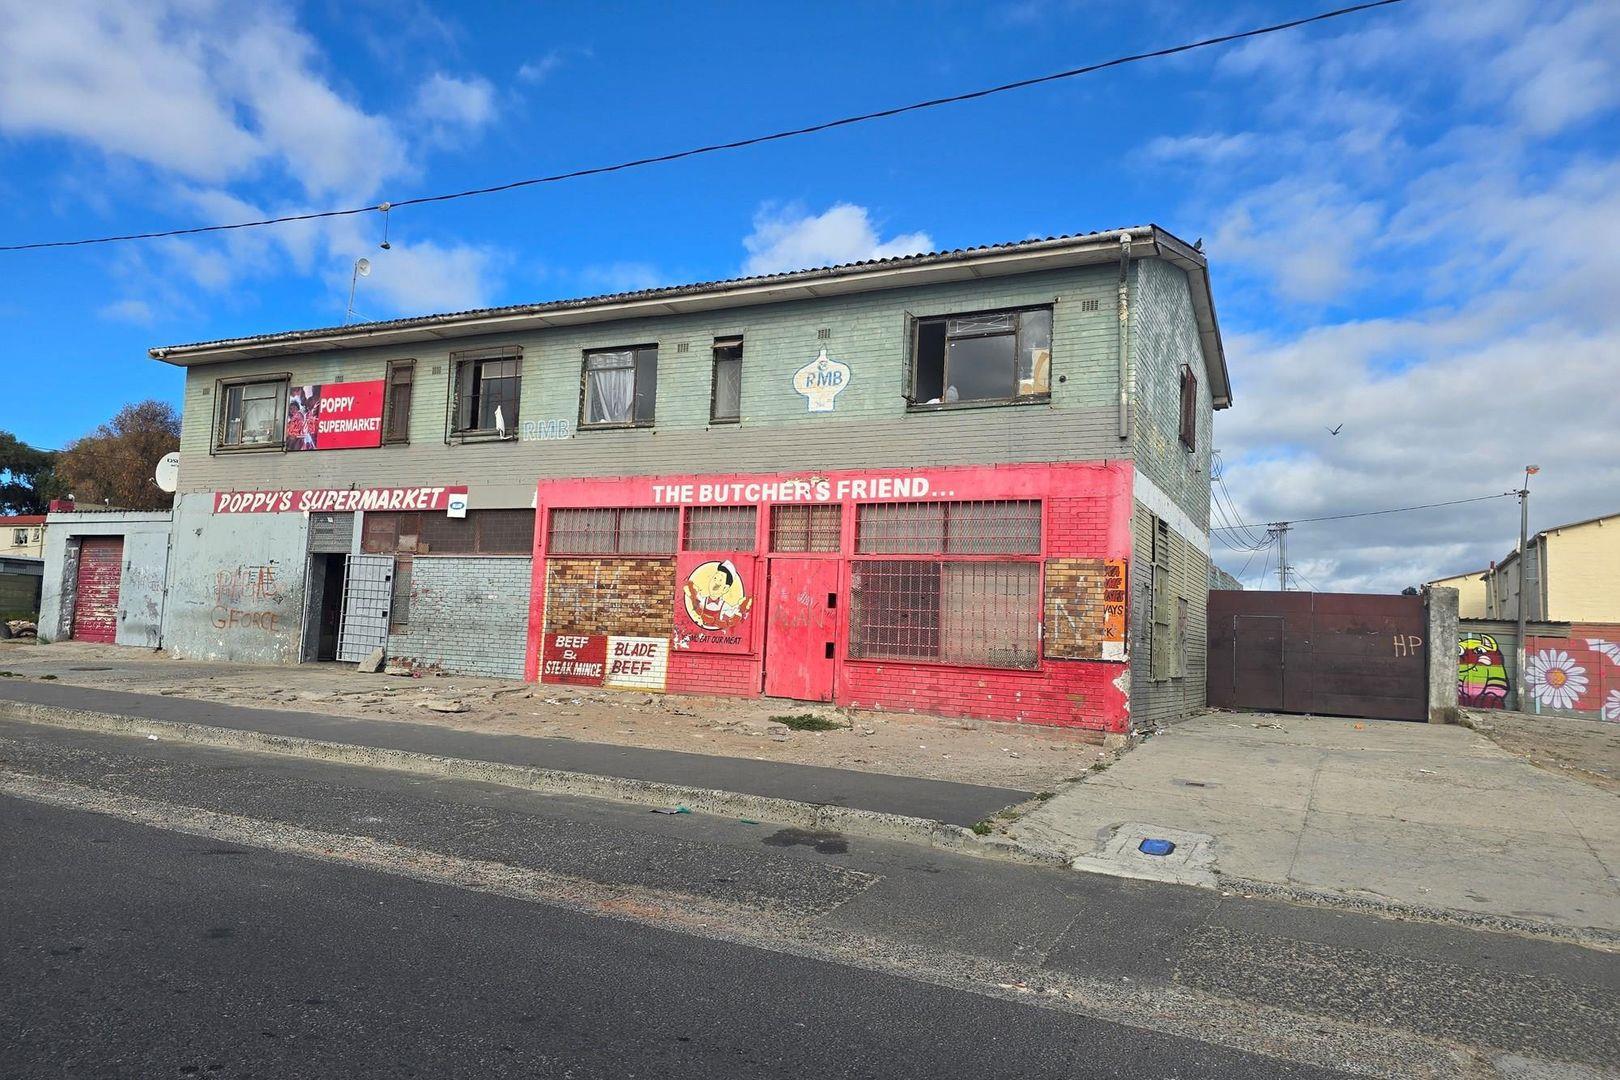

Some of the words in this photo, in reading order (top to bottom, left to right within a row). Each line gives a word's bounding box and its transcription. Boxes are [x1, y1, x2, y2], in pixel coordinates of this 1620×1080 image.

[805, 370, 843, 387] RMB
[320, 397, 354, 413] POPPY
[318, 418, 381, 433] SUPERMARKET
[523, 419, 570, 441] RMB
[652, 485, 694, 503] THE
[699, 480, 831, 502] BUTCHER'S
[837, 477, 954, 499] FRIEND...
[217, 491, 293, 513] POPPY'S
[298, 487, 445, 510] SUPERMARKET
[555, 635, 589, 648] BEEF
[724, 637, 742, 645] MEAT
[1393, 634, 1423, 658] HP
[563, 650, 577, 660] &
[614, 642, 657, 657] BLADE
[545, 661, 573, 675] STEAK
[573, 662, 602, 677] MINCE
[611, 660, 652, 675] BEEF
